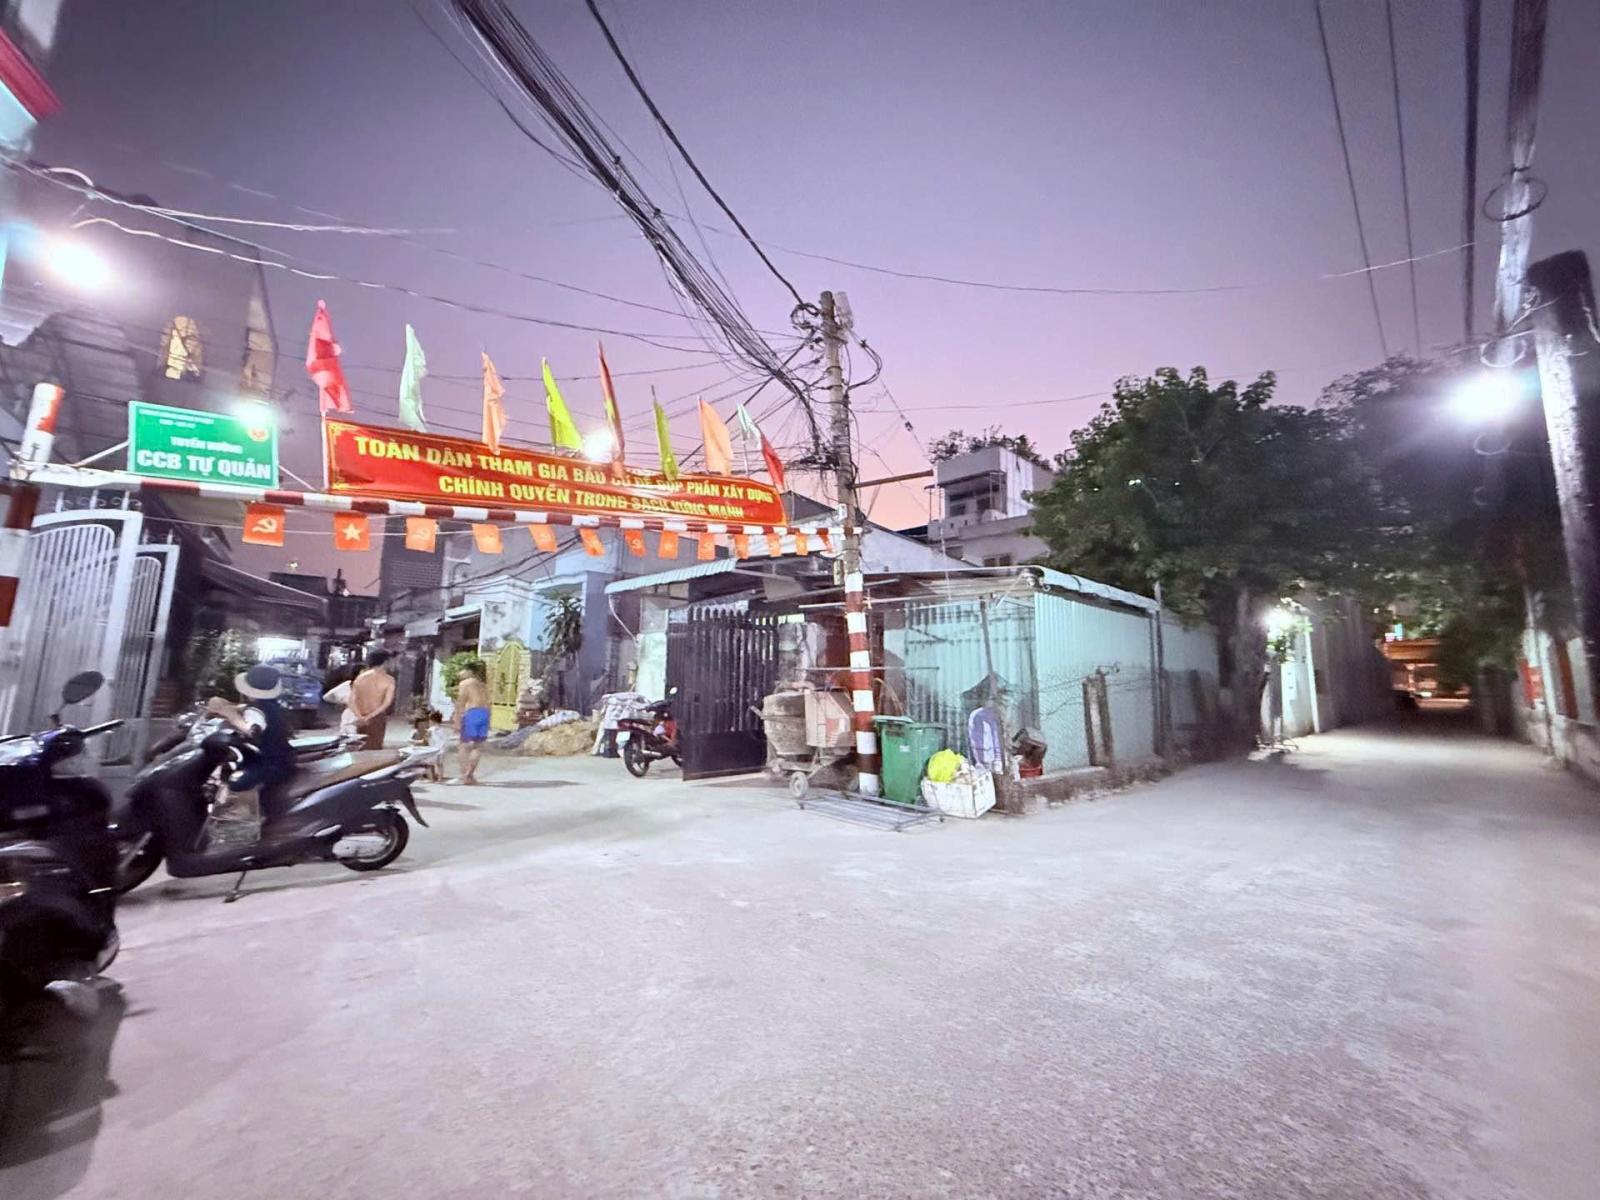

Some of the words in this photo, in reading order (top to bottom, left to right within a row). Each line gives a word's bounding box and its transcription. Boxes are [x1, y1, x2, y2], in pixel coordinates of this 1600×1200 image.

[137, 450, 182, 470] CCB
[186, 455, 216, 476] TỰ
[354, 436, 420, 461] TOÀN
[426, 447, 473, 468] DÂN
[477, 455, 533, 477] THAM
[537, 462, 569, 481] GIA
[723, 483, 744, 499] XÂY
[438, 475, 504, 498] CHÍNH
